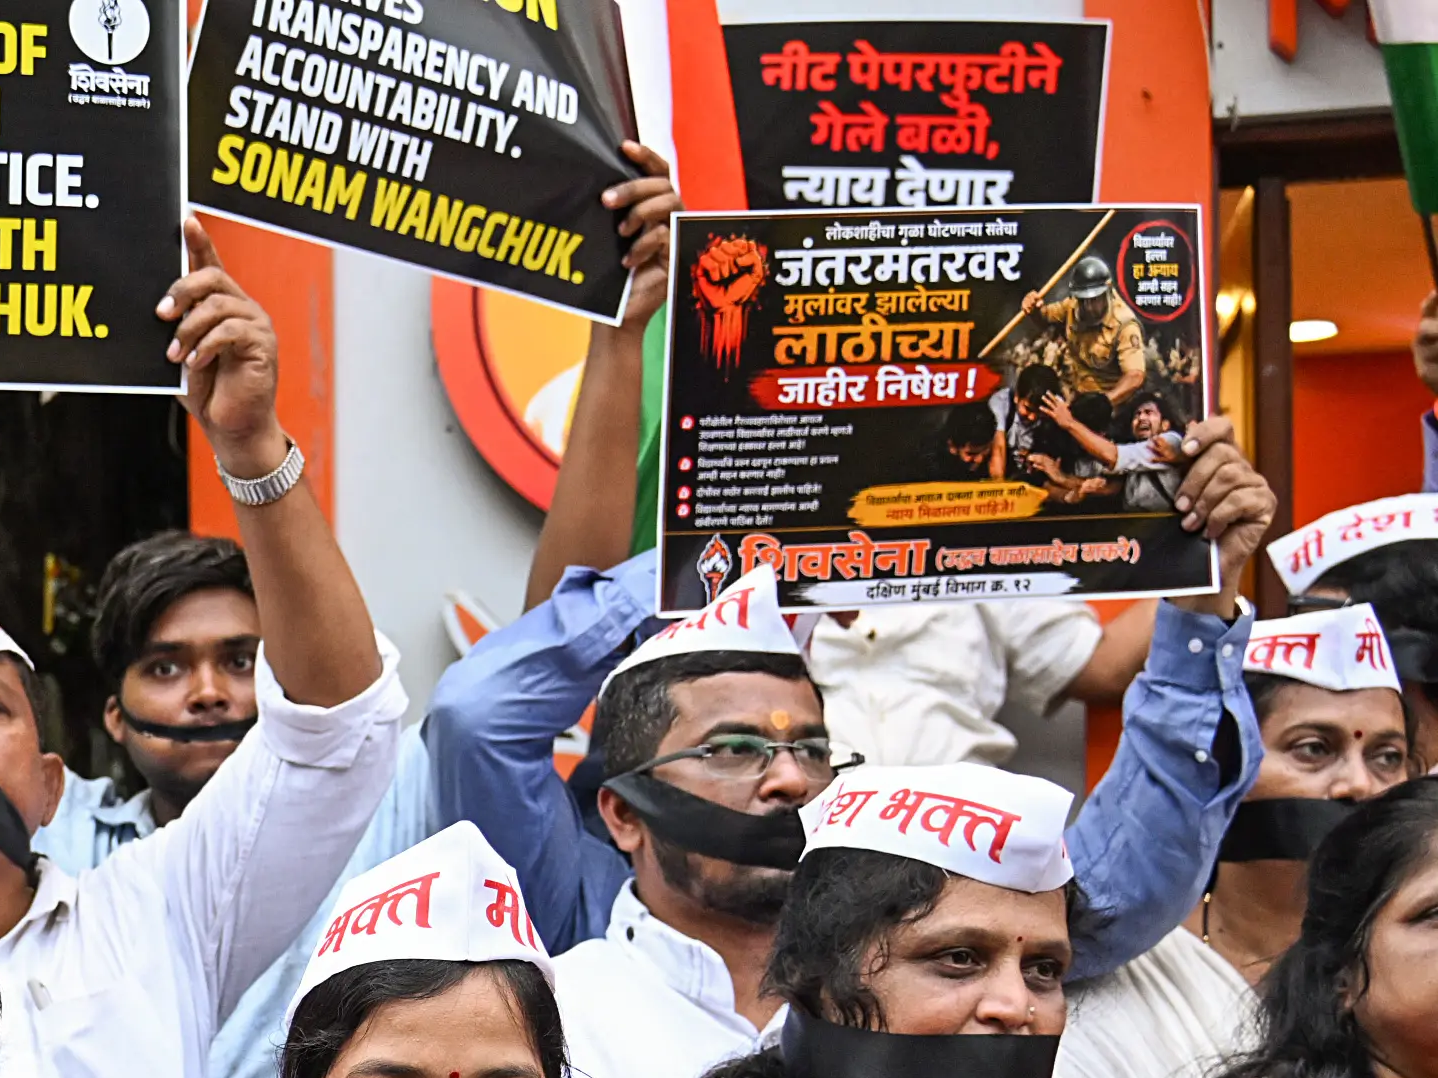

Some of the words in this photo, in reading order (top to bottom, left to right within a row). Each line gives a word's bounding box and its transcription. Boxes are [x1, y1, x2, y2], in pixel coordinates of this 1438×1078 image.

[68, 62, 150, 97] शिवसेना
[252, 0, 510, 101] TRANSPARENCY
[511, 69, 579, 125] AND
[760, 40, 842, 91] नीट
[235, 34, 523, 160] ACCOUNTABILITY.
[224, 85, 343, 155] STAND
[346, 118, 434, 182] WITH
[809, 99, 889, 152] गेले
[895, 103, 1000, 160] बळी,
[781, 165, 891, 207] न्याय
[894, 155, 1014, 207] देणार
[211, 134, 367, 221] SONAM
[370, 177, 586, 285] WANGCHUK.
[774, 237, 1024, 287] जंतरमंतरवर
[783, 287, 870, 324] मुलांवर
[874, 284, 971, 316] झालेल्या
[772, 313, 975, 365] लाठीच्या
[777, 366, 869, 407] जाहीर
[737, 530, 932, 583] शिवसेना
[866, 578, 905, 600] दक्षिण
[910, 575, 941, 601] मुंबई
[945, 577, 987, 595] विभाग
[879, 788, 1022, 865] भक्त
[318, 871, 441, 957] भक्त
